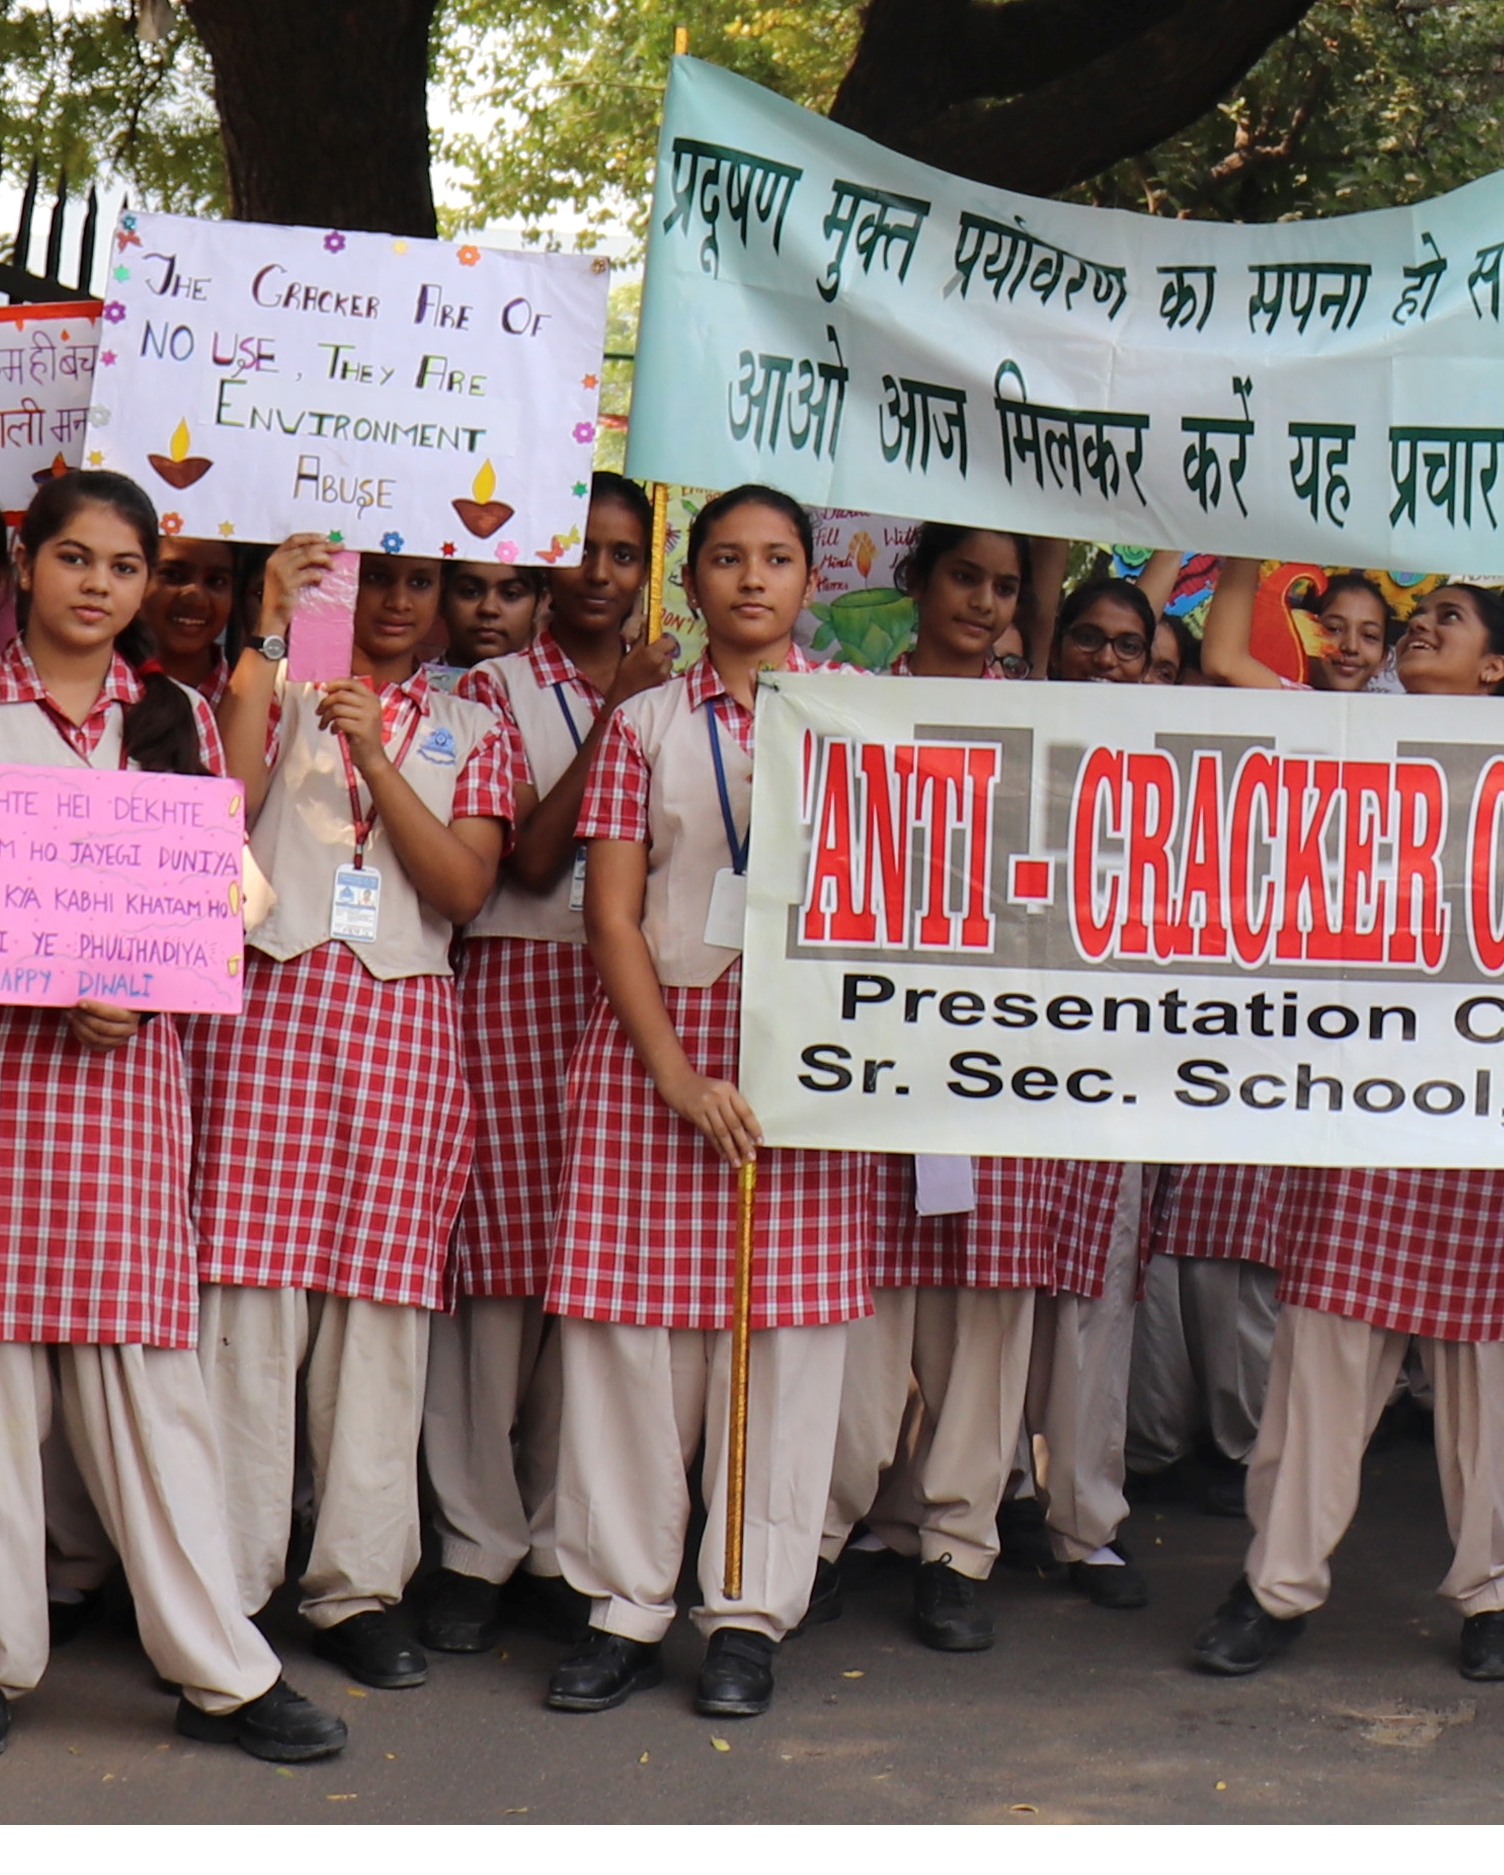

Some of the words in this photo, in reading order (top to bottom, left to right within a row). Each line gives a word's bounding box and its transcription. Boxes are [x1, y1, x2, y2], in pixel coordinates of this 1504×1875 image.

[662, 137, 804, 281] प्रदूषण
[816, 178, 932, 304] मुक्त
[1156, 264, 1218, 334] का
[1246, 261, 1374, 336] सपना
[1391, 231, 1448, 325] हो
[30, 330, 57, 386] ही
[139, 319, 196, 363] NO
[726, 323, 850, 465] आओ
[877, 373, 968, 481] आज
[992, 357, 1152, 508] मिलकर
[1180, 375, 1256, 519] करें
[1287, 421, 1357, 530] यह
[56, 793, 91, 819] HEI
[114, 796, 206, 828] DEKHTE
[30, 841, 58, 863] HO
[69, 841, 143, 867] JAYEGI
[158, 846, 239, 876] DUNIYA
[1068, 743, 1453, 976] CRACKER
[4, 883, 42, 910] KYA
[54, 887, 115, 914] KABHI
[126, 893, 202, 919] KHATAM
[208, 900, 229, 920] HO
[31, 931, 60, 958] YE
[77, 970, 154, 998] DIWALI
[841, 972, 1419, 1042] Presentation
[796, 1042, 911, 1096] Sr.
[946, 1050, 1139, 1106] Sec.
